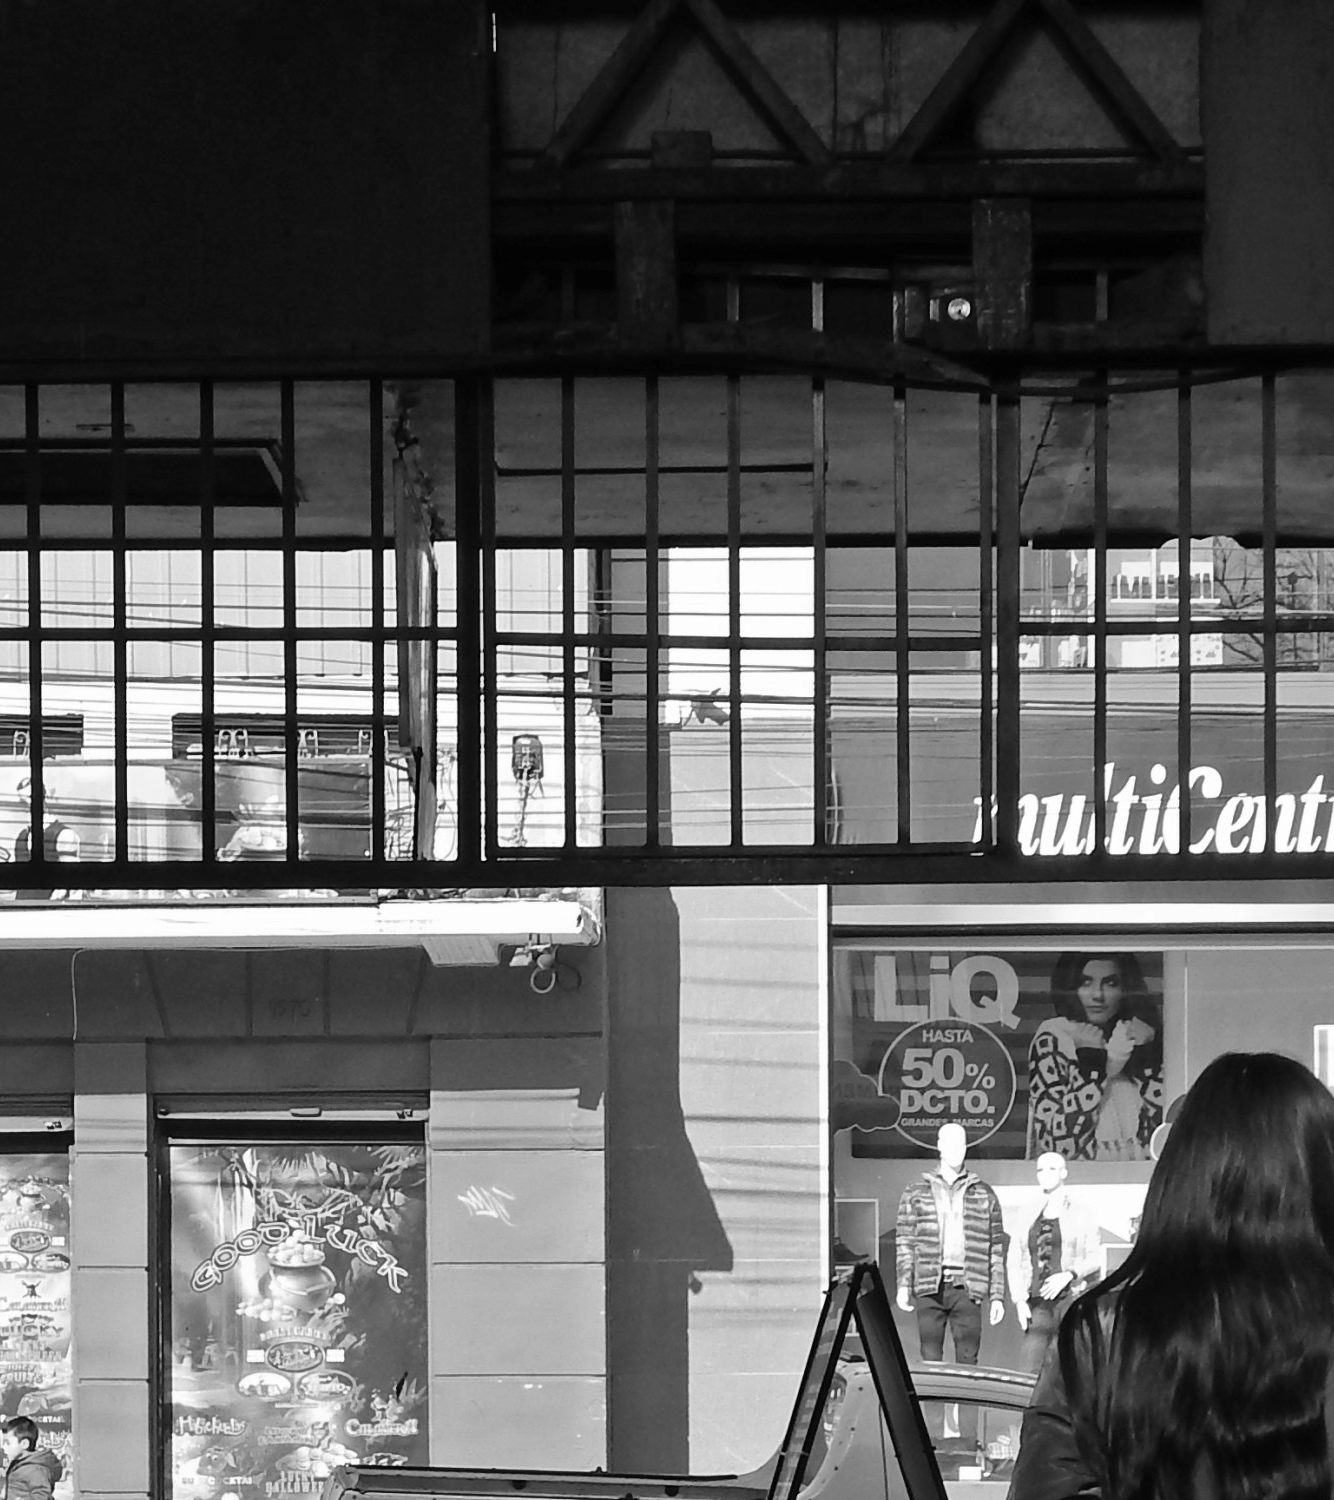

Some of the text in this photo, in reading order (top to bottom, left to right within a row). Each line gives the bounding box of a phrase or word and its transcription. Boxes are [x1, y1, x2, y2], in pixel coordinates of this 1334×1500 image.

[922, 1029, 974, 1043] HASTA
[901, 1048, 995, 1089] 50%
[900, 1089, 995, 1114] DCTO.
[191, 1214, 409, 1294] GOOD LUCK
